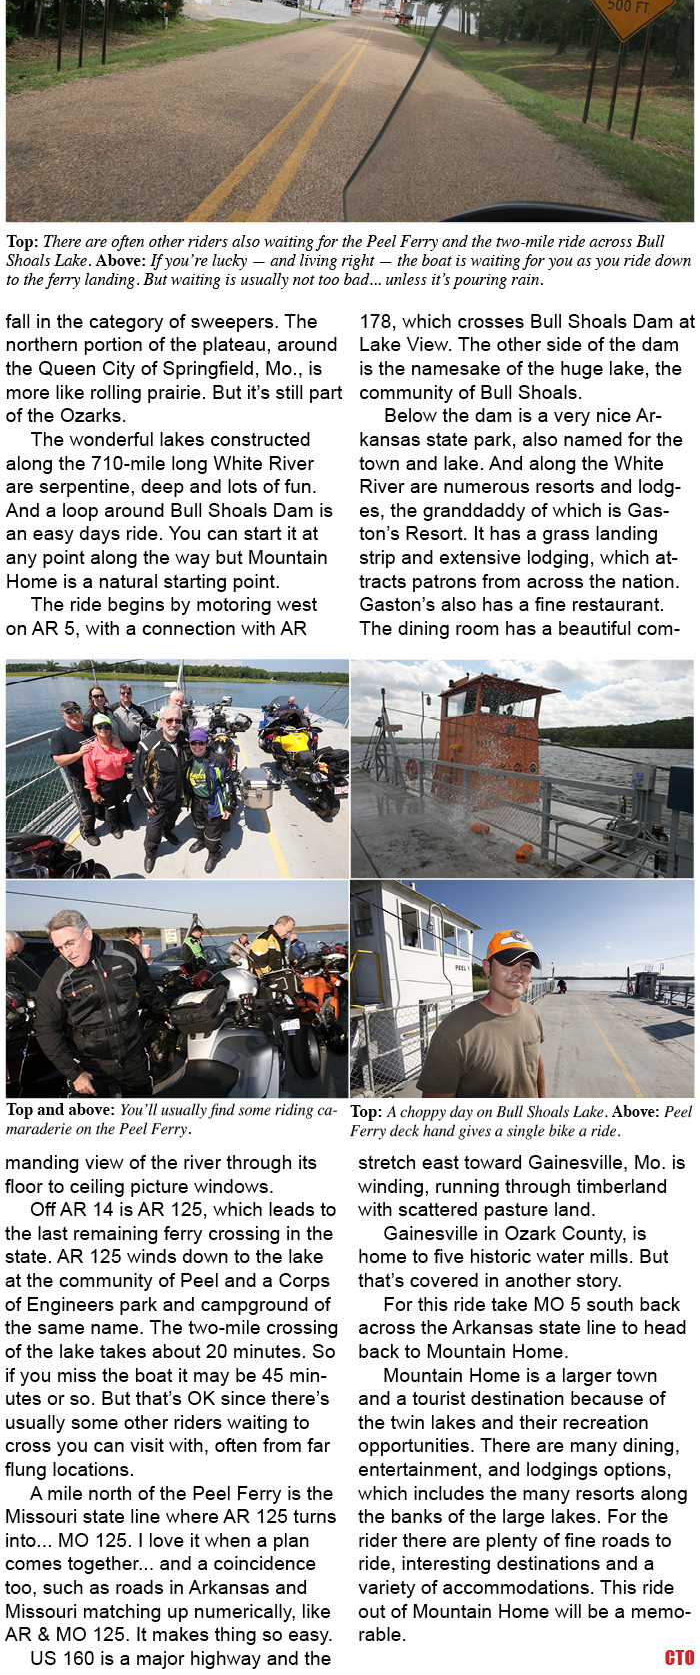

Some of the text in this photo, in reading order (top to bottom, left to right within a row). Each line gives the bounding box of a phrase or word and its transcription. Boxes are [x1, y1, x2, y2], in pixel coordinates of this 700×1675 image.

[636, 1, 651, 14] FT.
[5, 313, 318, 333] fall in the category of sweepers. The
[360, 313, 696, 332] 178, which crosses Bull Shoals Dam at
[455, 964, 467, 972] PEEL
[357, 1201, 596, 1221] with scattered pasture land.
[4, 1626, 333, 1646] AR & MO 125. It makes thing so easy.
